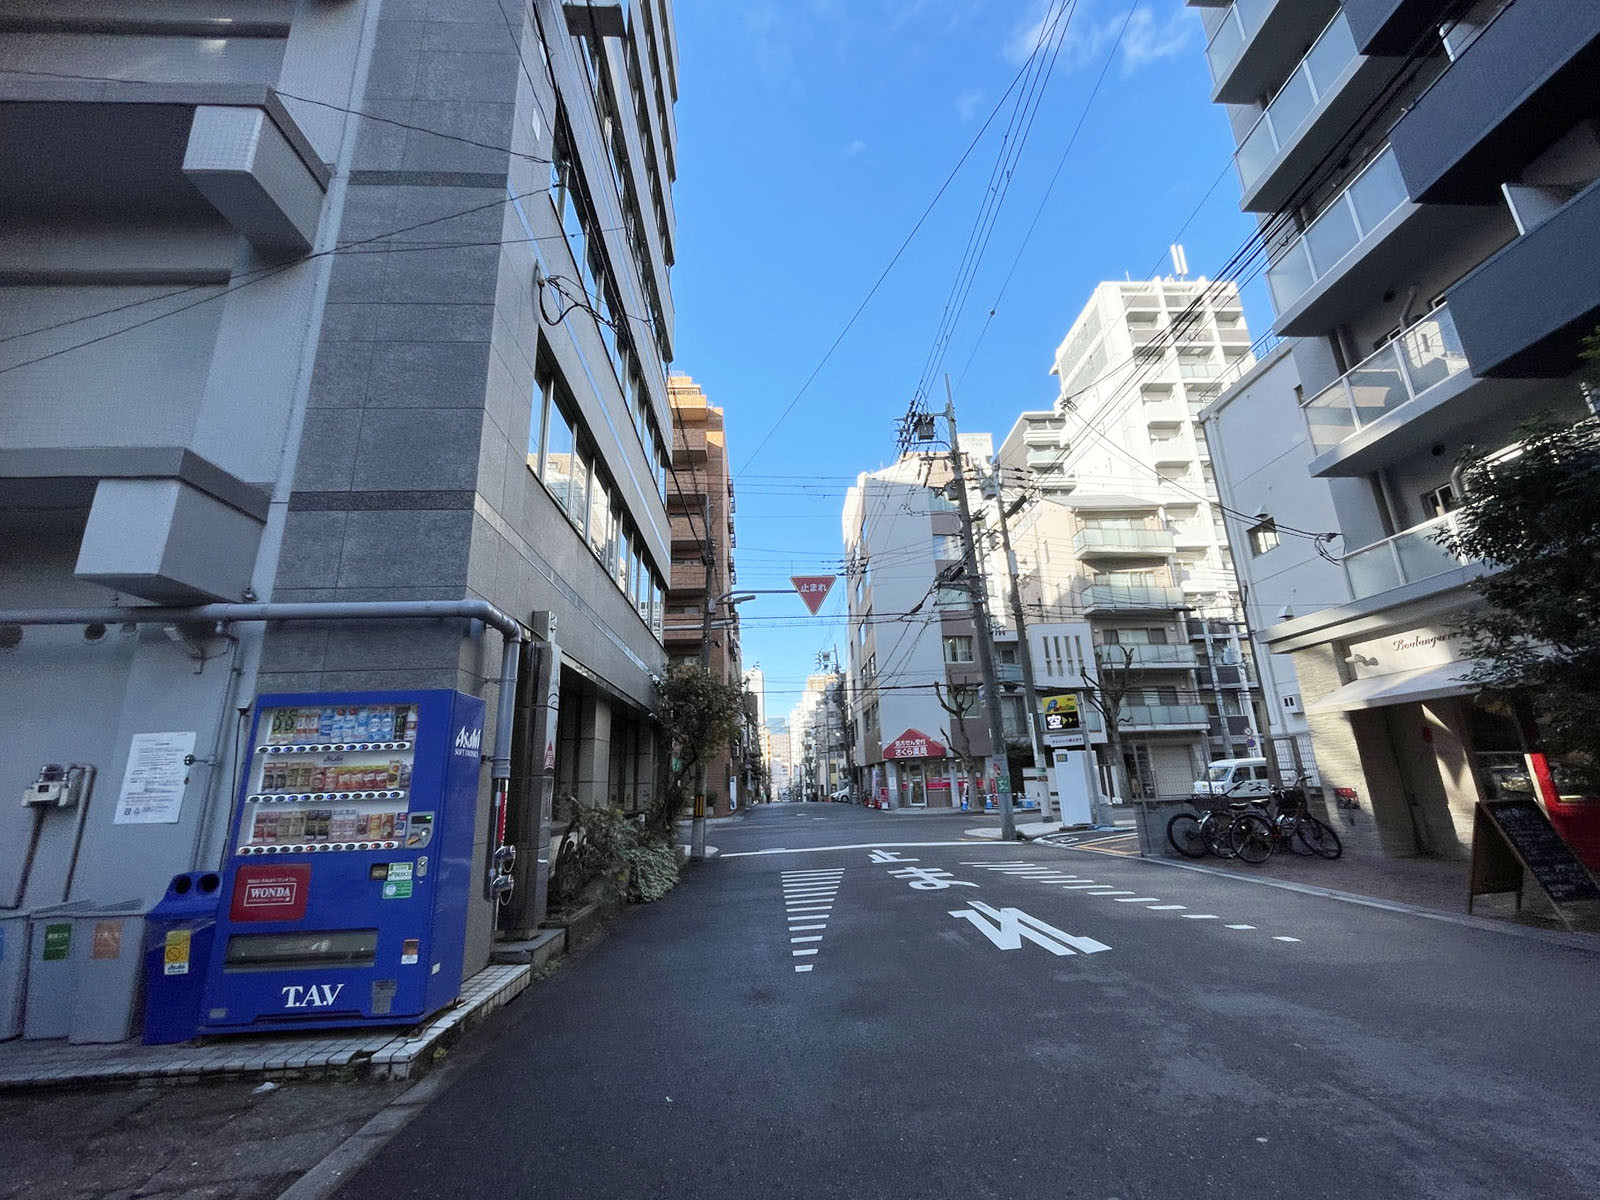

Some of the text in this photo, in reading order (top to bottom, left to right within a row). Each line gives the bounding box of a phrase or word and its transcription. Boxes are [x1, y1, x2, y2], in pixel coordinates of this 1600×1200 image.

[800, 583, 827, 593] 止まれ
[250, 886, 291, 899] WONDA
